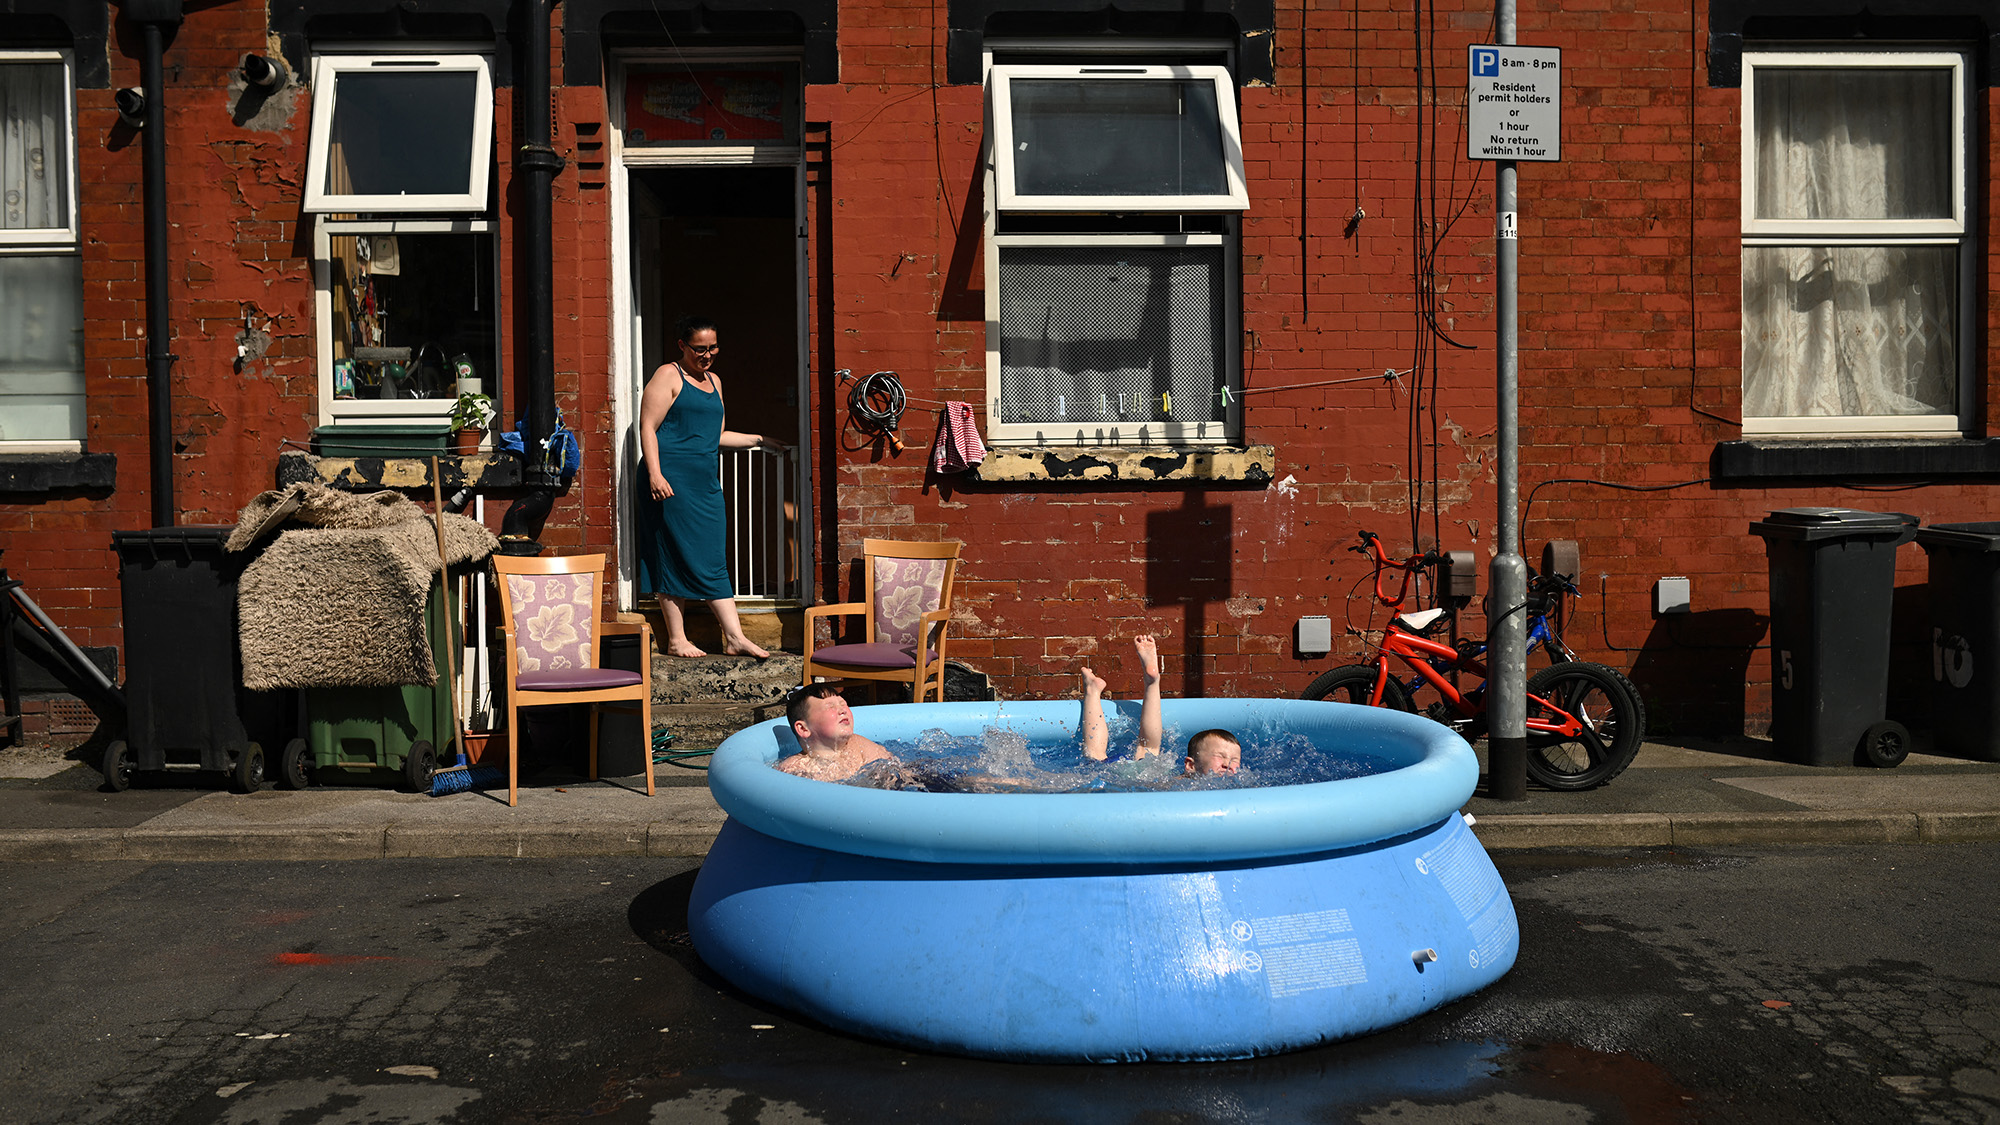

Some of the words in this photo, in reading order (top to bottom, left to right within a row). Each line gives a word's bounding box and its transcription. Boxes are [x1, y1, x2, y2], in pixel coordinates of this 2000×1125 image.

[1479, 52, 1495, 74] P
[1502, 58, 1508, 67] 8
[1510, 60, 1525, 68] am
[1533, 60, 1539, 68] 8
[1541, 61, 1557, 70] pm
[1493, 82, 1536, 92] Resident
[1478, 93, 1511, 103] permit
[1514, 94, 1551, 104] holders
[1509, 109, 1520, 117] or
[1499, 122, 1503, 131] 1
[1507, 122, 1530, 131] hour
[1490, 135, 1505, 144] No
[1507, 136, 1539, 145] return
[1482, 146, 1513, 155] within
[1516, 147, 1520, 155] 1
[1523, 147, 1546, 156] hour
[1505, 213, 1512, 228] 1
[1932, 627, 1974, 688] 10
[1780, 650, 1793, 690] 5
